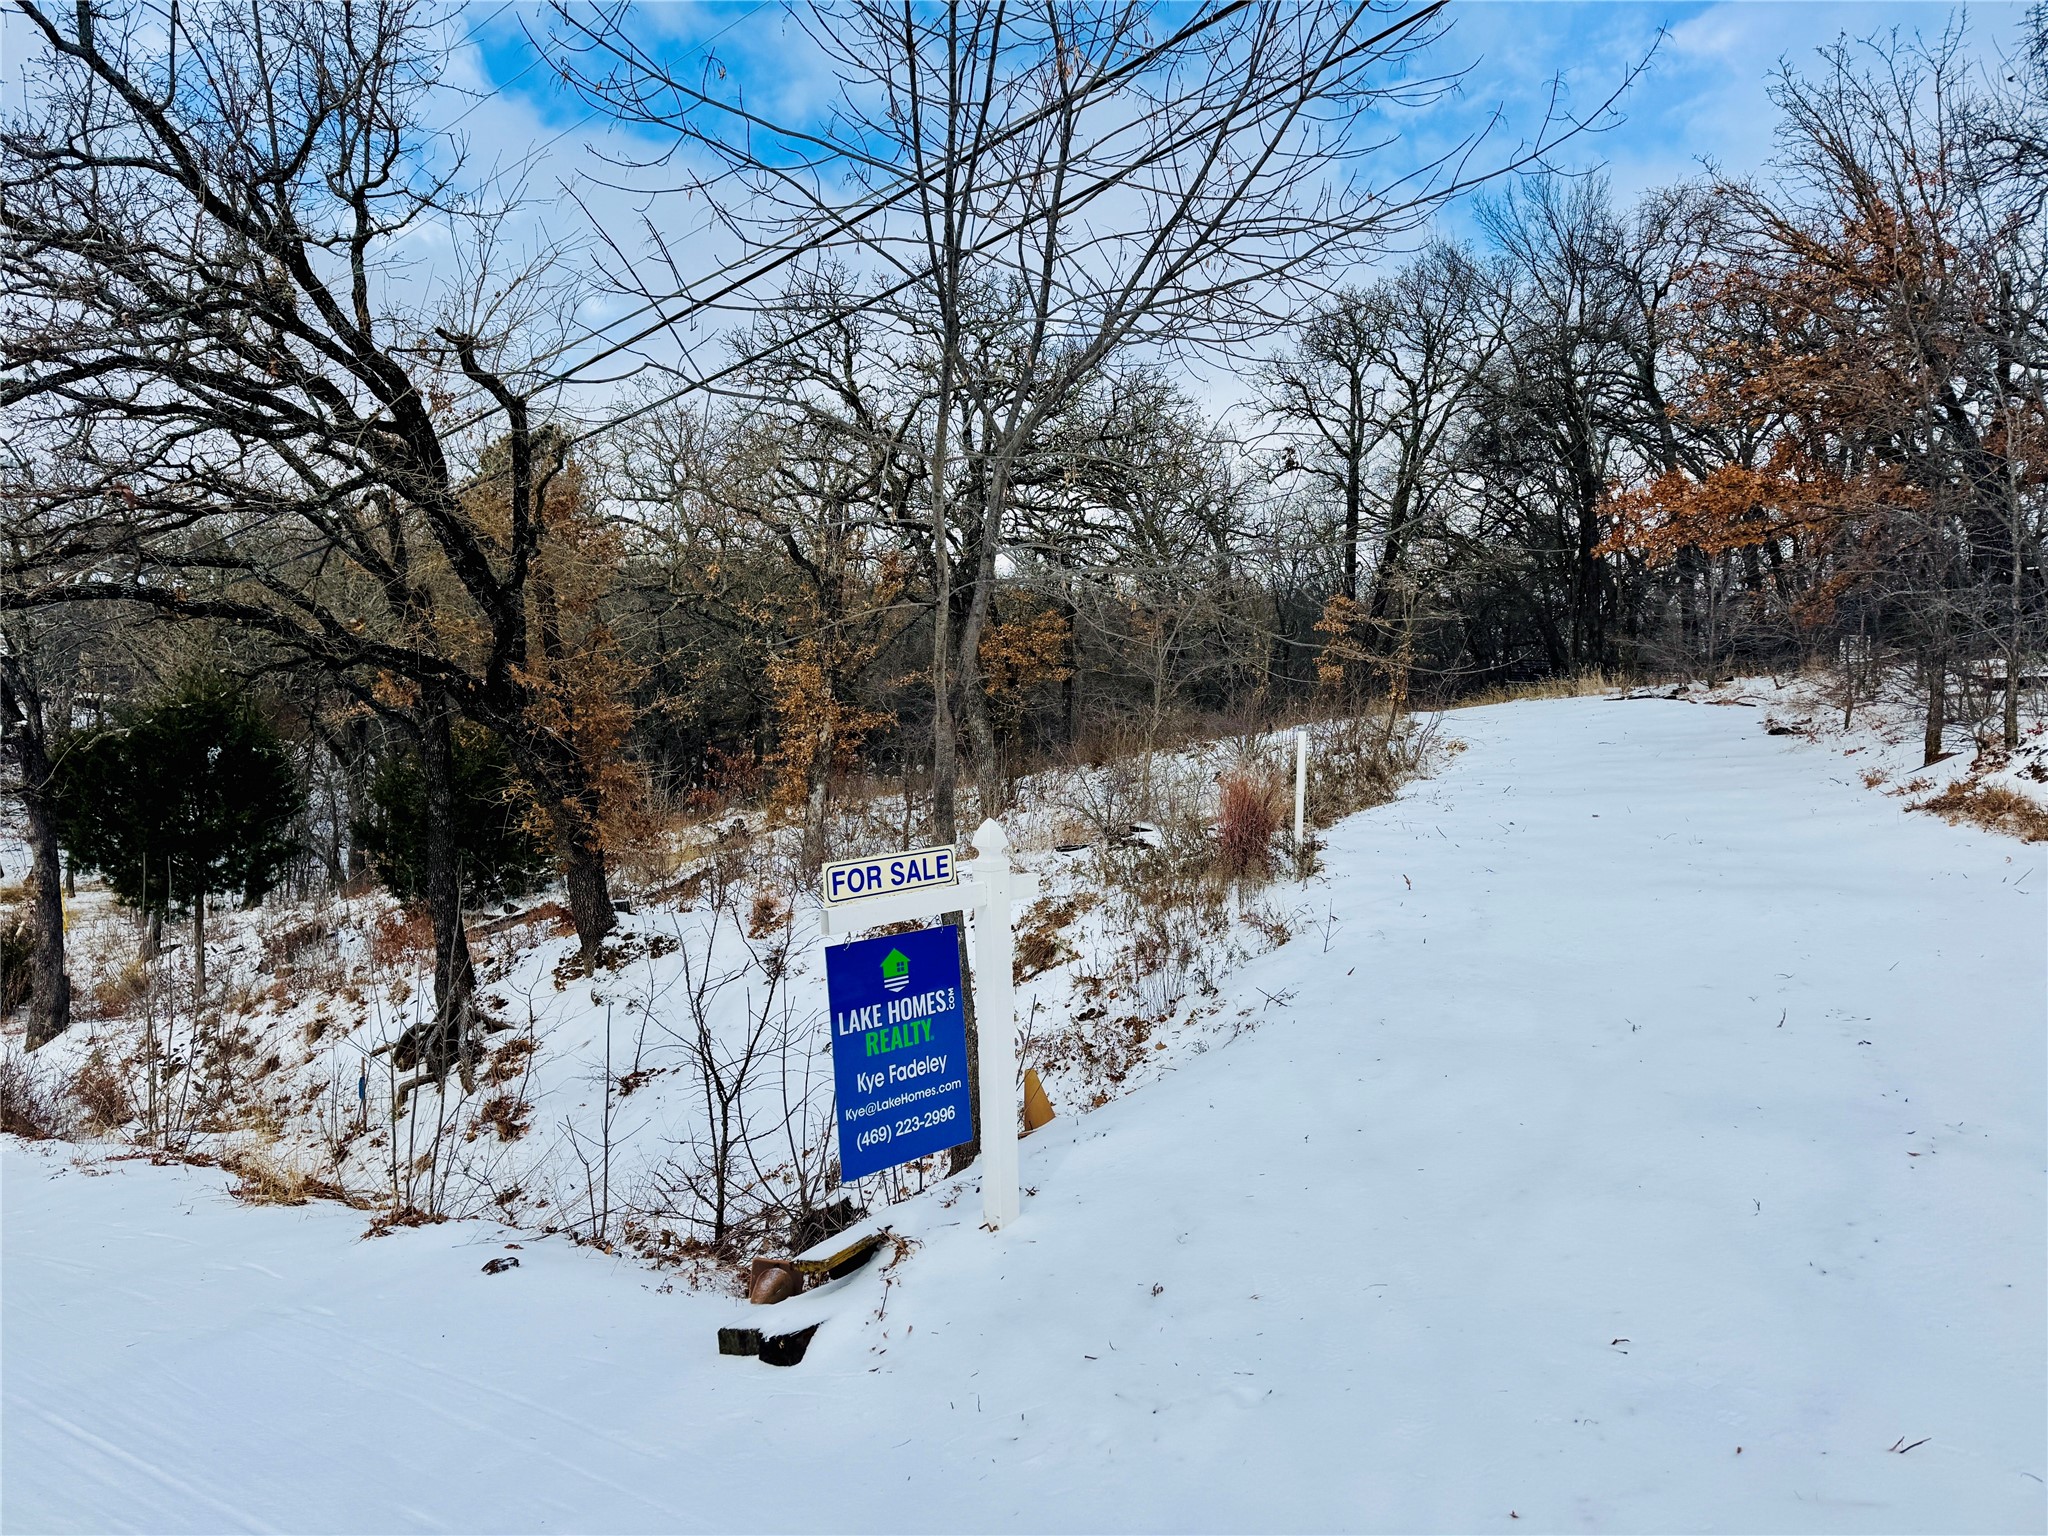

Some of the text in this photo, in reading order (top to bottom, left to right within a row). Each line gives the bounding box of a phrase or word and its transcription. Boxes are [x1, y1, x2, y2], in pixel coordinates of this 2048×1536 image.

[831, 854, 950, 896] FOR SALE
[838, 1004, 882, 1036] LAKE
[887, 990, 946, 1023] HOMES
[865, 1018, 932, 1056] REALTY
[857, 1055, 948, 1093] Kye Fadeley
[845, 1078, 962, 1121] Kye@LakeHomes.com
[856, 1105, 956, 1152] (469) 223-2996
